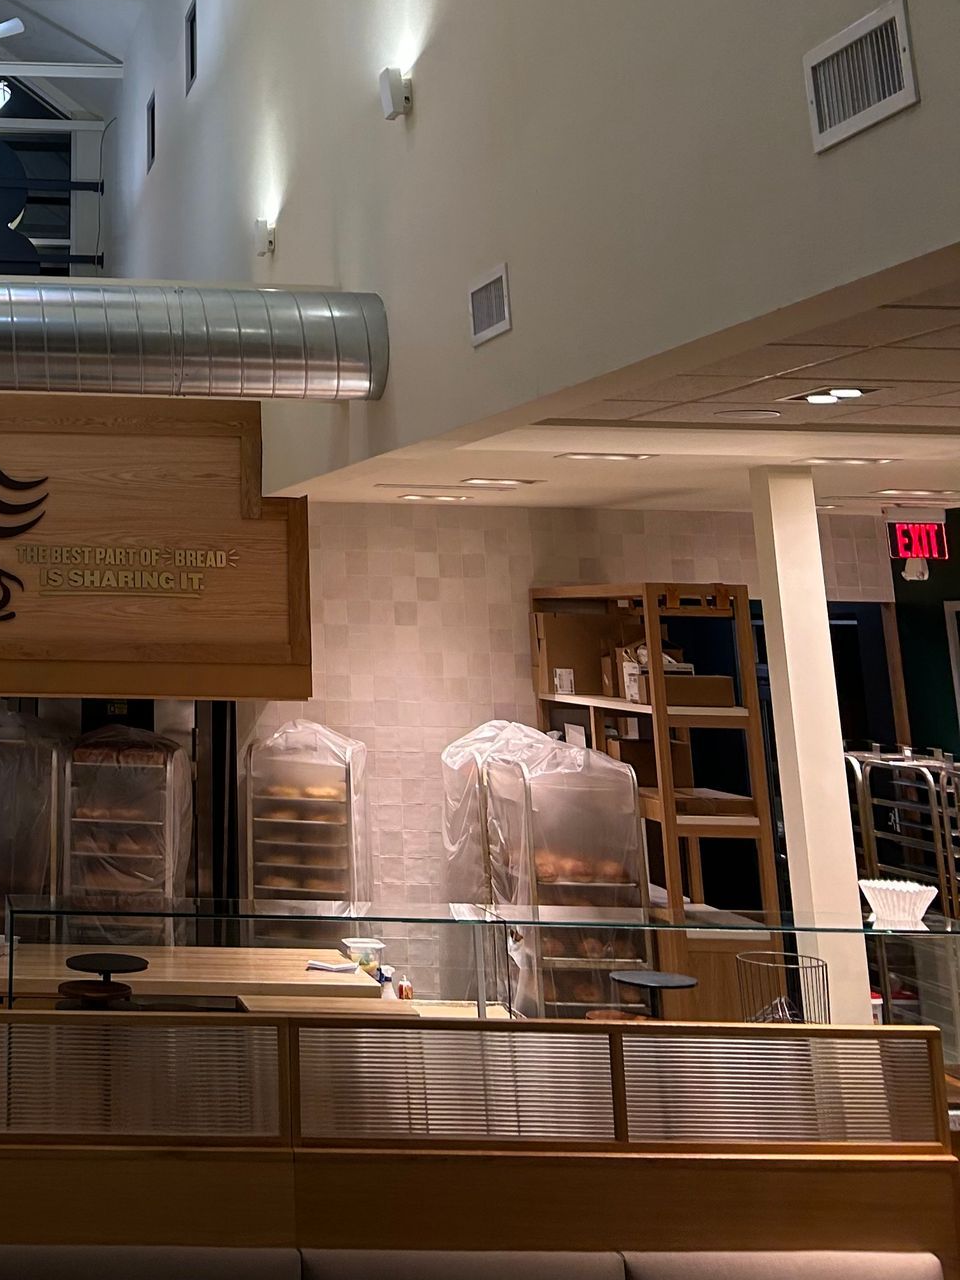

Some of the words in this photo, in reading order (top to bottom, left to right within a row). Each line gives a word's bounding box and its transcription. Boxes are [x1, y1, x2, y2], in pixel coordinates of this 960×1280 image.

[896, 524, 938, 558] EXIT
[17, 545, 48, 564] THE
[49, 546, 92, 565] BEST
[95, 547, 139, 566] PART
[140, 548, 161, 566] OF
[174, 549, 227, 568] BREAD
[39, 568, 64, 587] IS
[67, 569, 174, 590] SHARING
[179, 571, 205, 590] IT.
